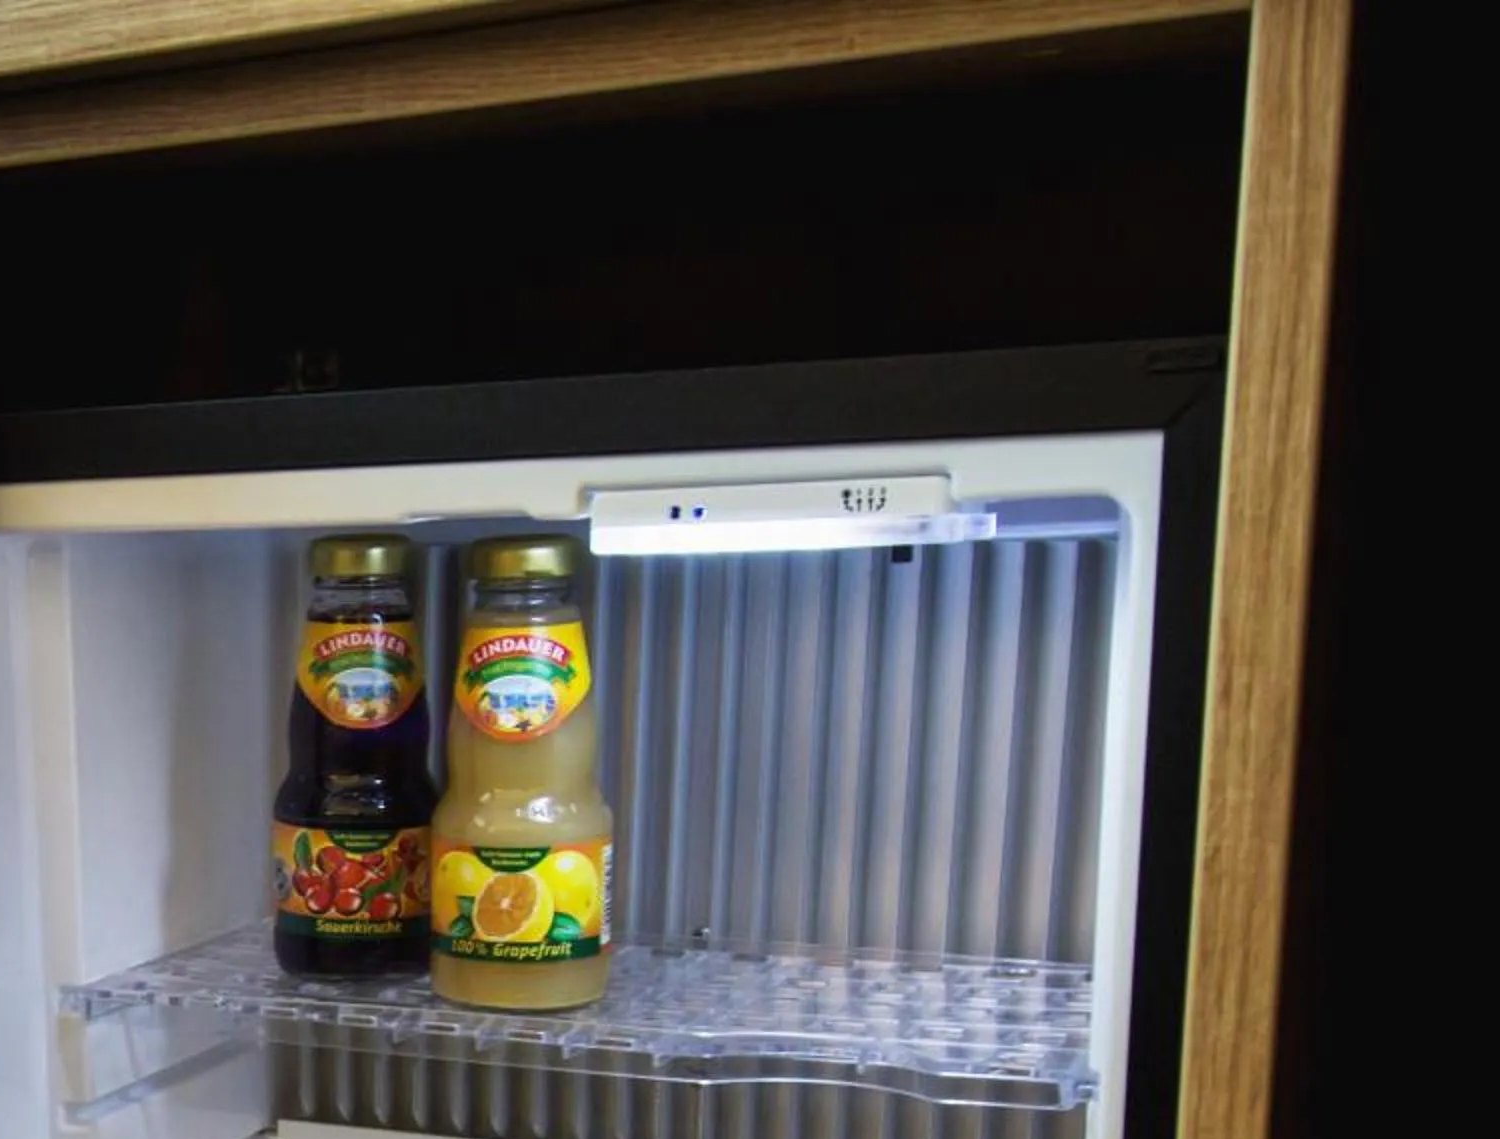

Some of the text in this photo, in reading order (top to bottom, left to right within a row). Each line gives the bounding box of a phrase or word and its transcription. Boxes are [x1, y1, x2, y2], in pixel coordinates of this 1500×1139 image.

[319, 631, 406, 657] LINDAUER
[473, 636, 566, 663] LINDAUER
[492, 940, 572, 961] Grapefruit
